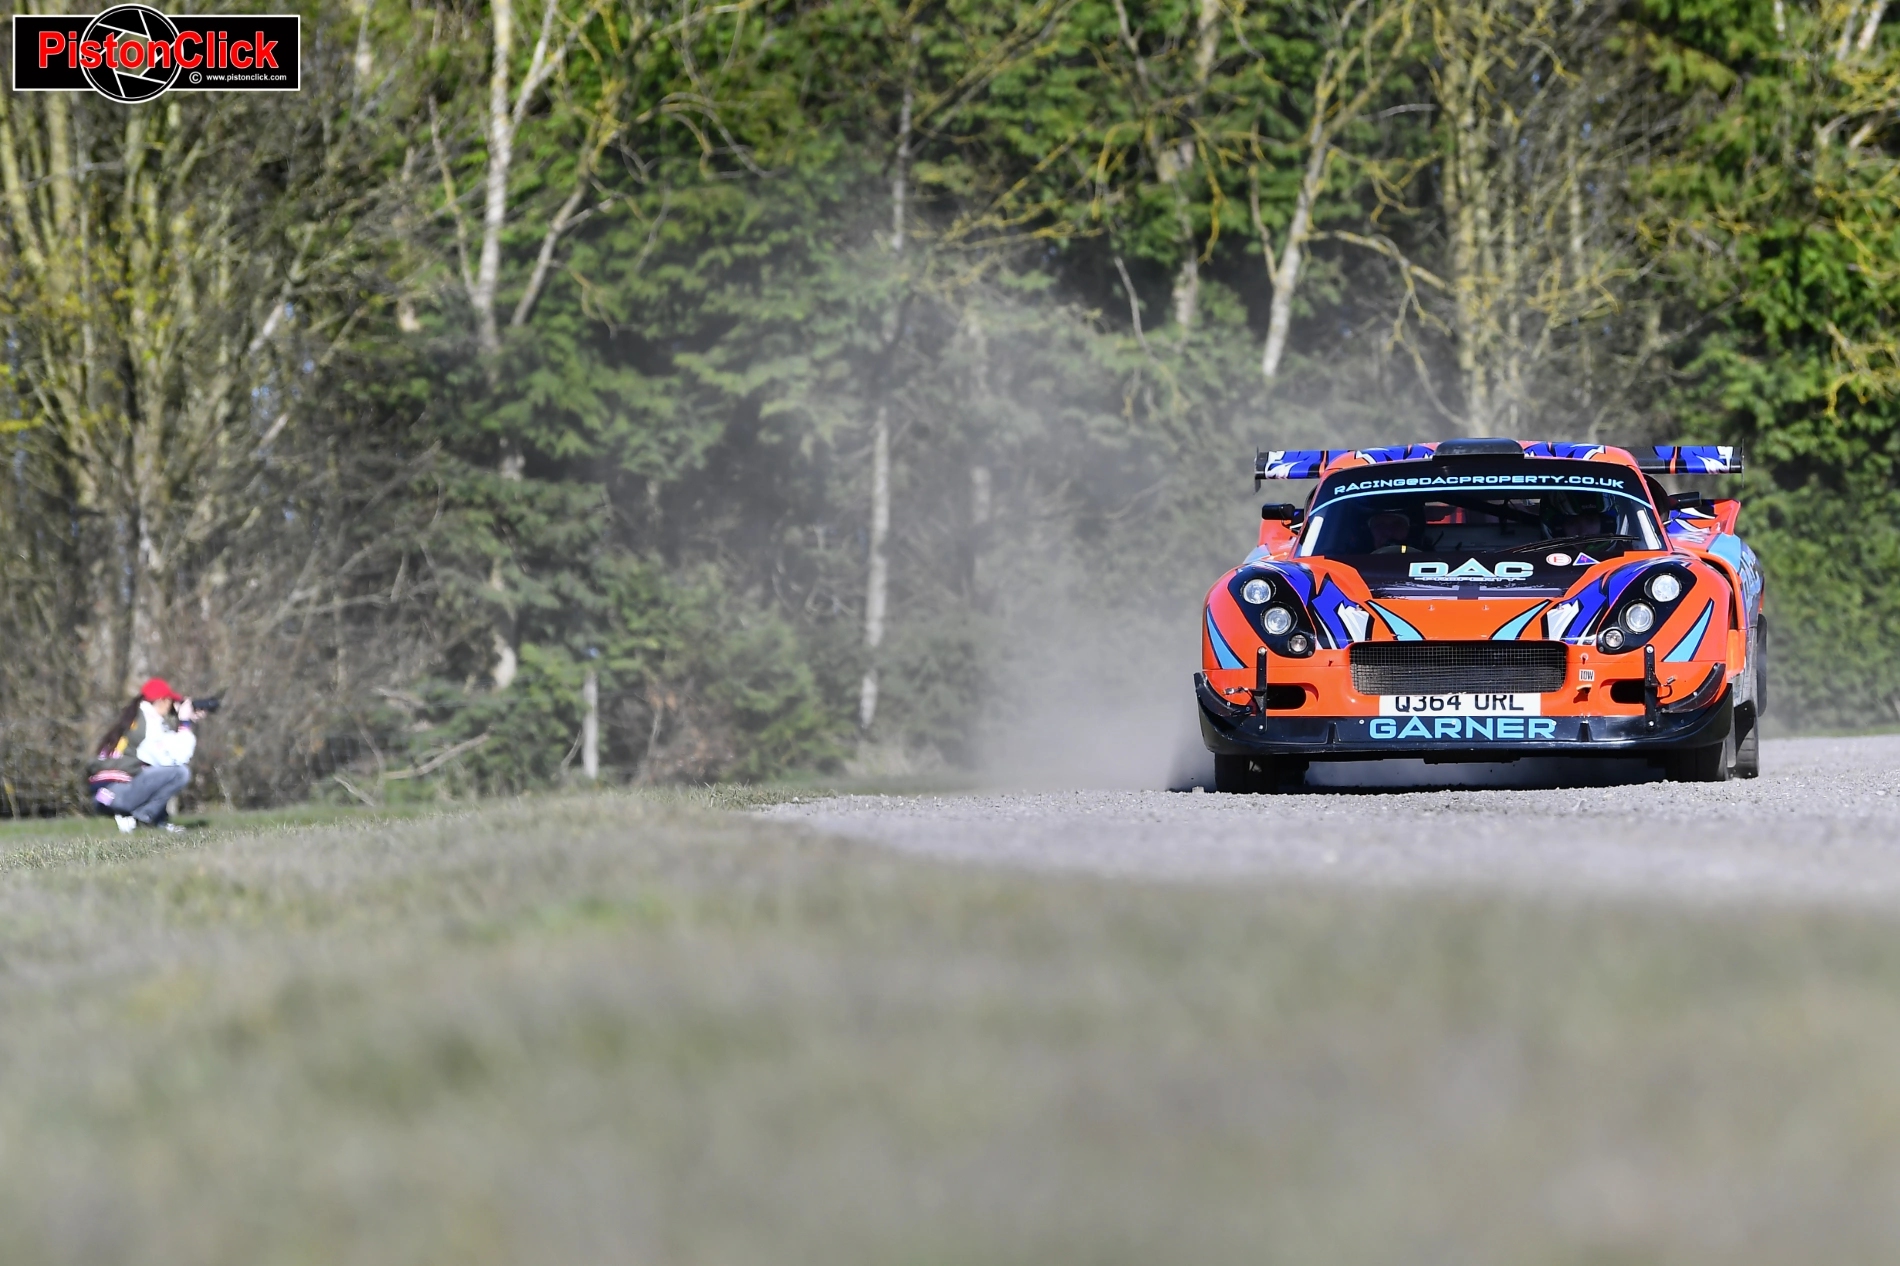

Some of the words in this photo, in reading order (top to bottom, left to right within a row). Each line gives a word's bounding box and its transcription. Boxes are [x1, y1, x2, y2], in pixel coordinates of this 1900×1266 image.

[1334, 475, 1624, 495] RACING@DACPROPERTY.CO.UK
[1408, 558, 1534, 578] DAC
[1580, 670, 1594, 680] TOW
[1395, 694, 1462, 712] Q364
[1369, 716, 1557, 740] GARNER
